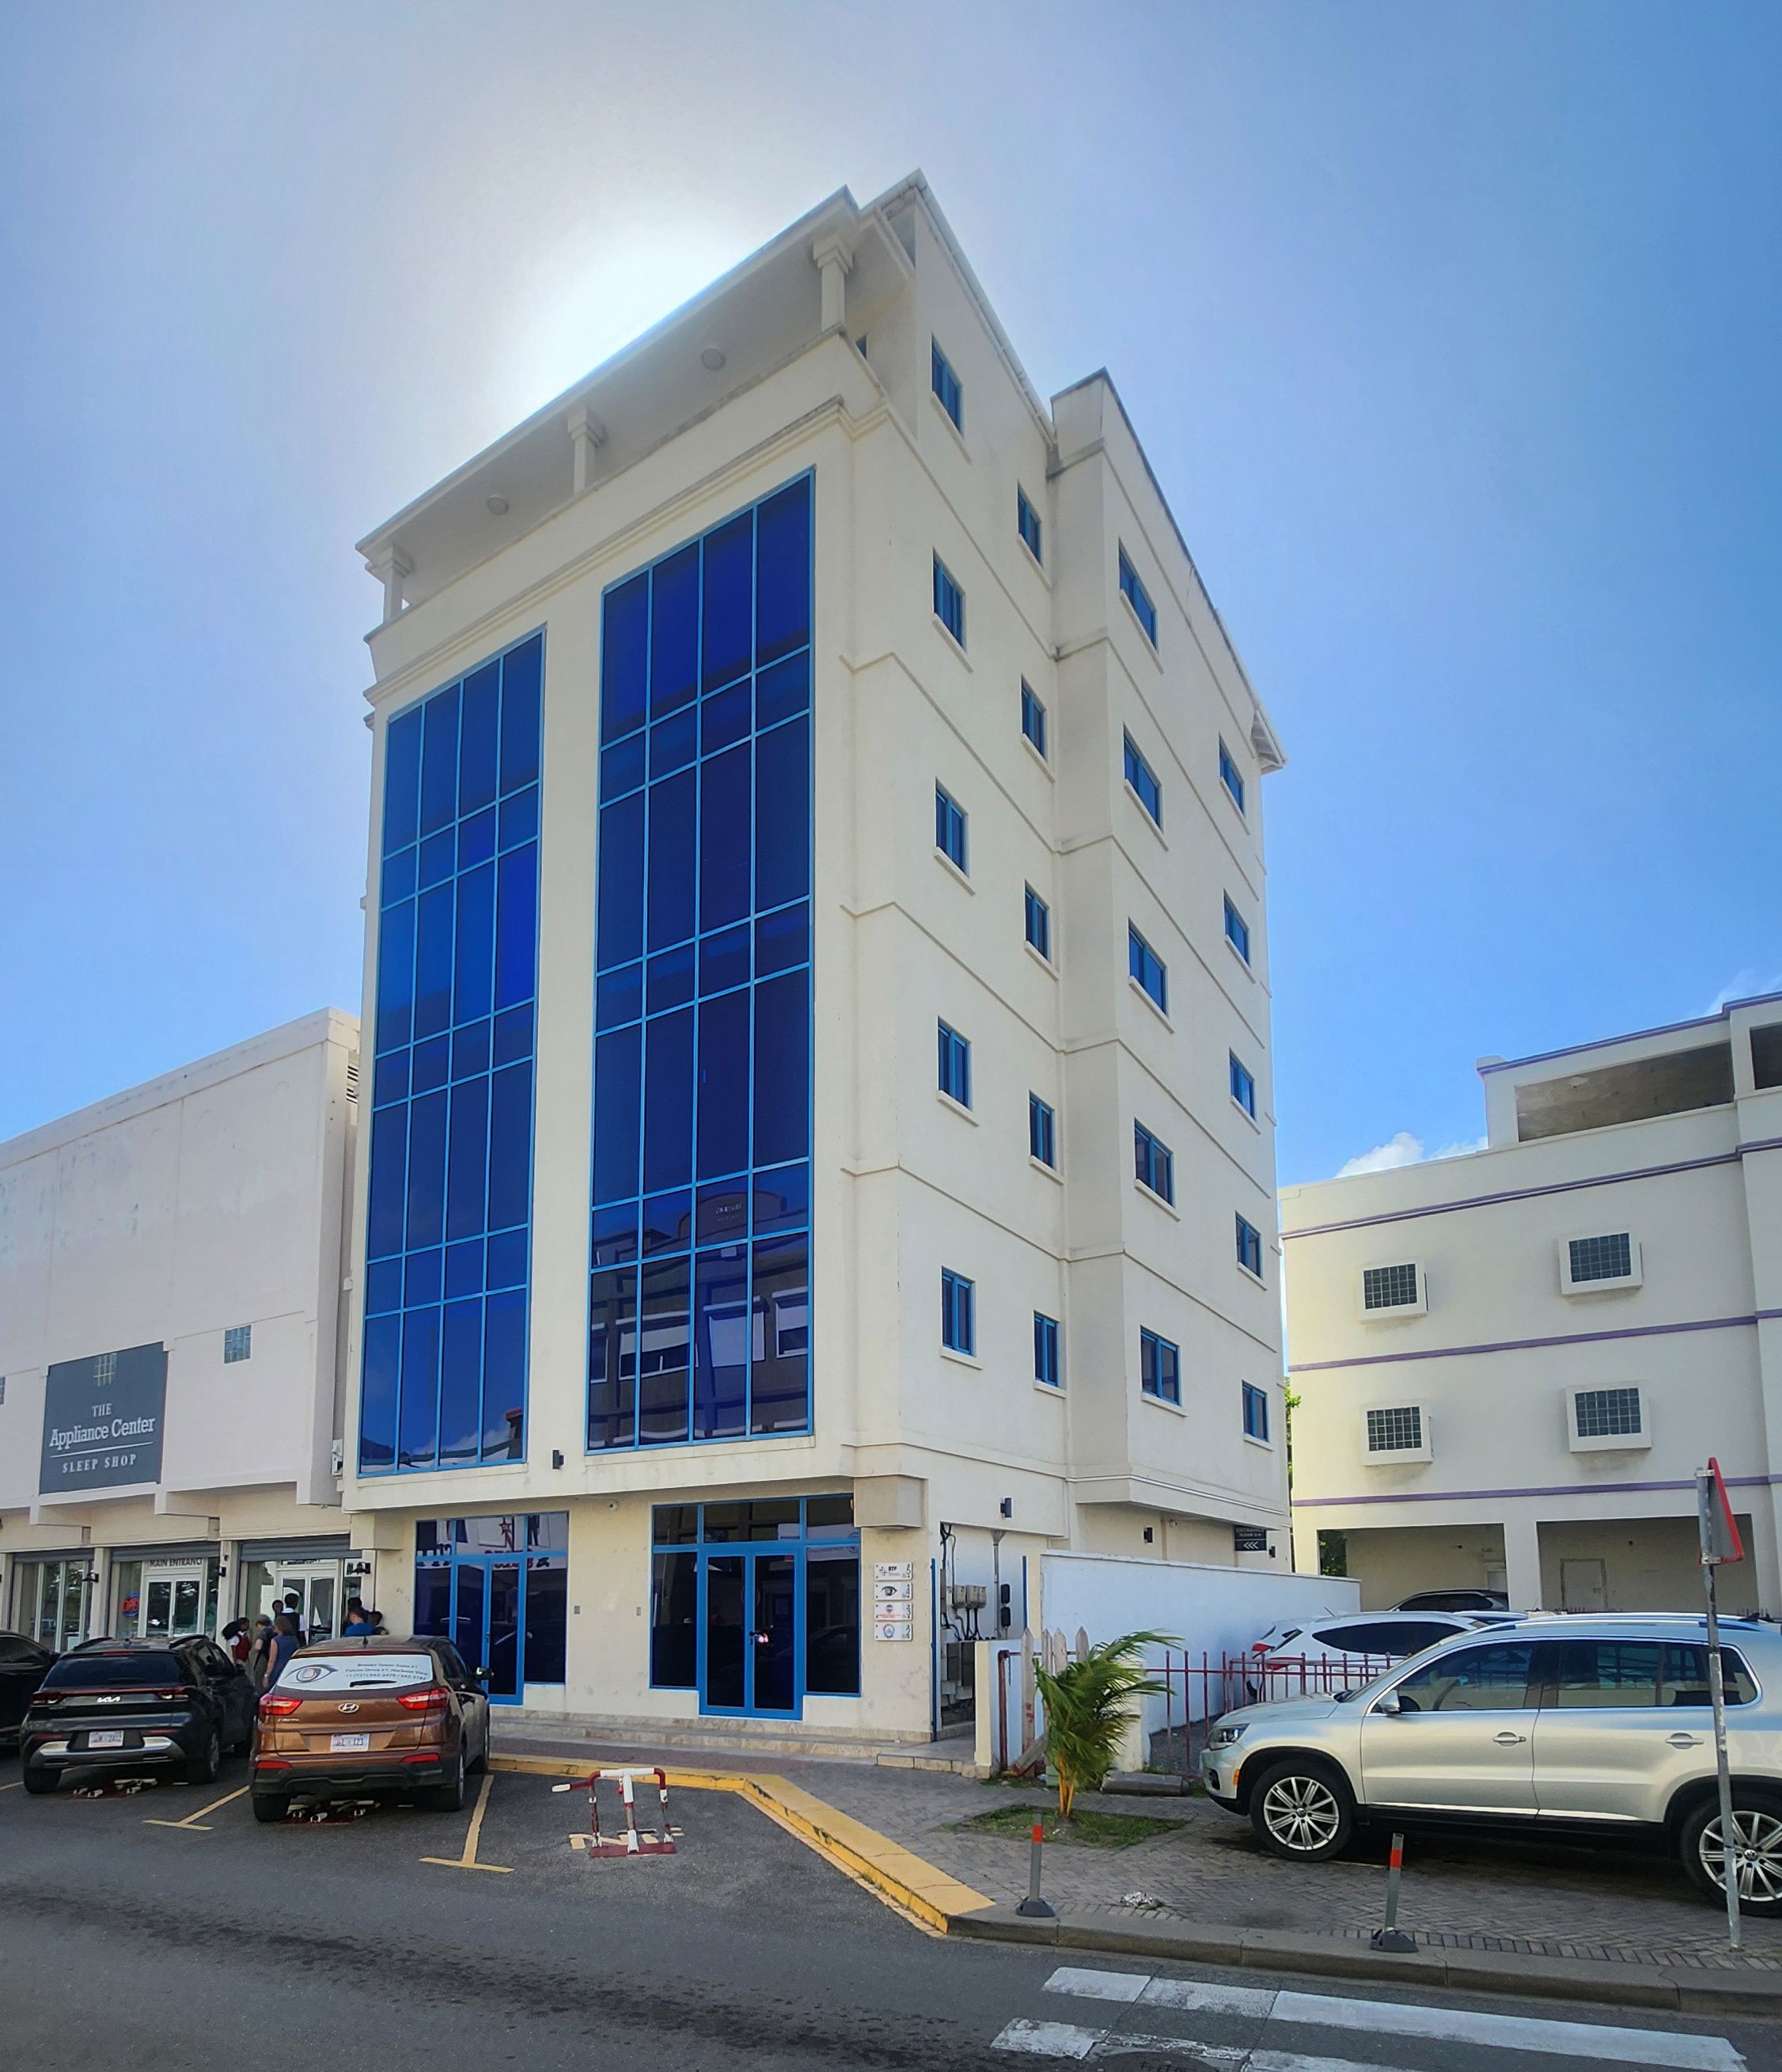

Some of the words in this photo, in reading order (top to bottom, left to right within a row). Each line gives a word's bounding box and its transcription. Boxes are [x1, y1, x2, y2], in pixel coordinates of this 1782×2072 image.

[92, 1403, 112, 1417] THE
[49, 1425, 108, 1450] Appliance
[111, 1417, 156, 1437] Center
[63, 1459, 98, 1474] SLEEP
[104, 1454, 136, 1468] SHOP
[150, 1558, 168, 1567] MAIN
[169, 1558, 203, 1566] ENTRANC
